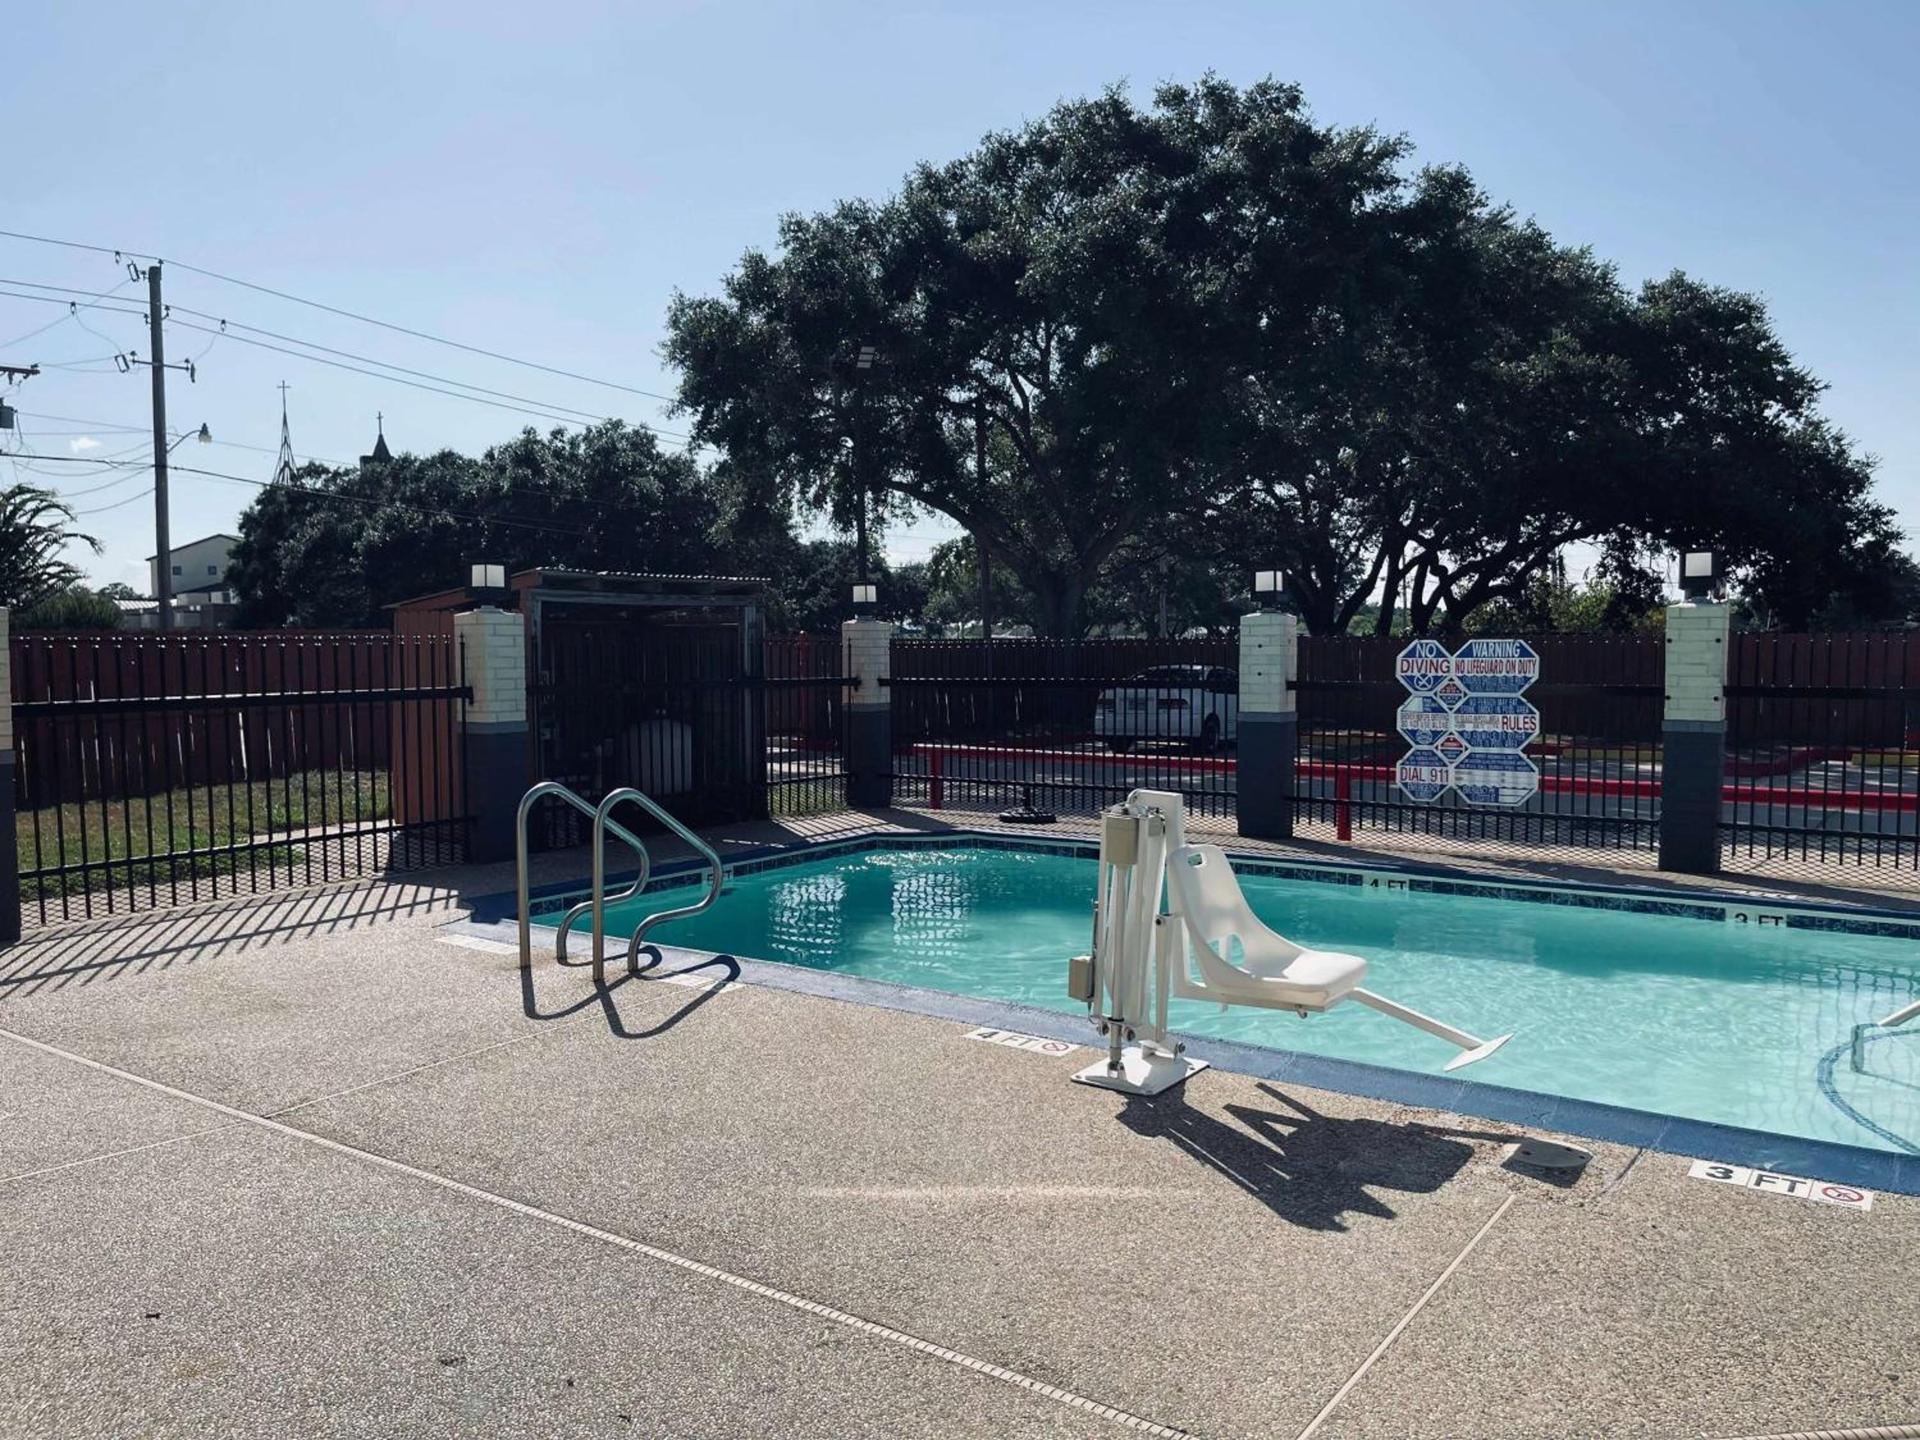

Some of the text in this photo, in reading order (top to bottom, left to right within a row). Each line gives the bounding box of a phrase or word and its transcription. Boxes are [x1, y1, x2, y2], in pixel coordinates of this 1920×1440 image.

[1416, 643, 1437, 658] NO
[1472, 642, 1520, 657] WARNING
[1400, 659, 1451, 674] DIVING
[1455, 659, 1537, 674] NO LIFEGUARD ON DUTY
[1501, 715, 1537, 731] RULES
[1400, 767, 1449, 783] DIAL 911
[1387, 880, 1407, 890] FT
[1758, 915, 1784, 926] FT
[977, 1031, 1039, 1046] 4 FT
[1705, 1166, 1806, 1194] 3 FT
